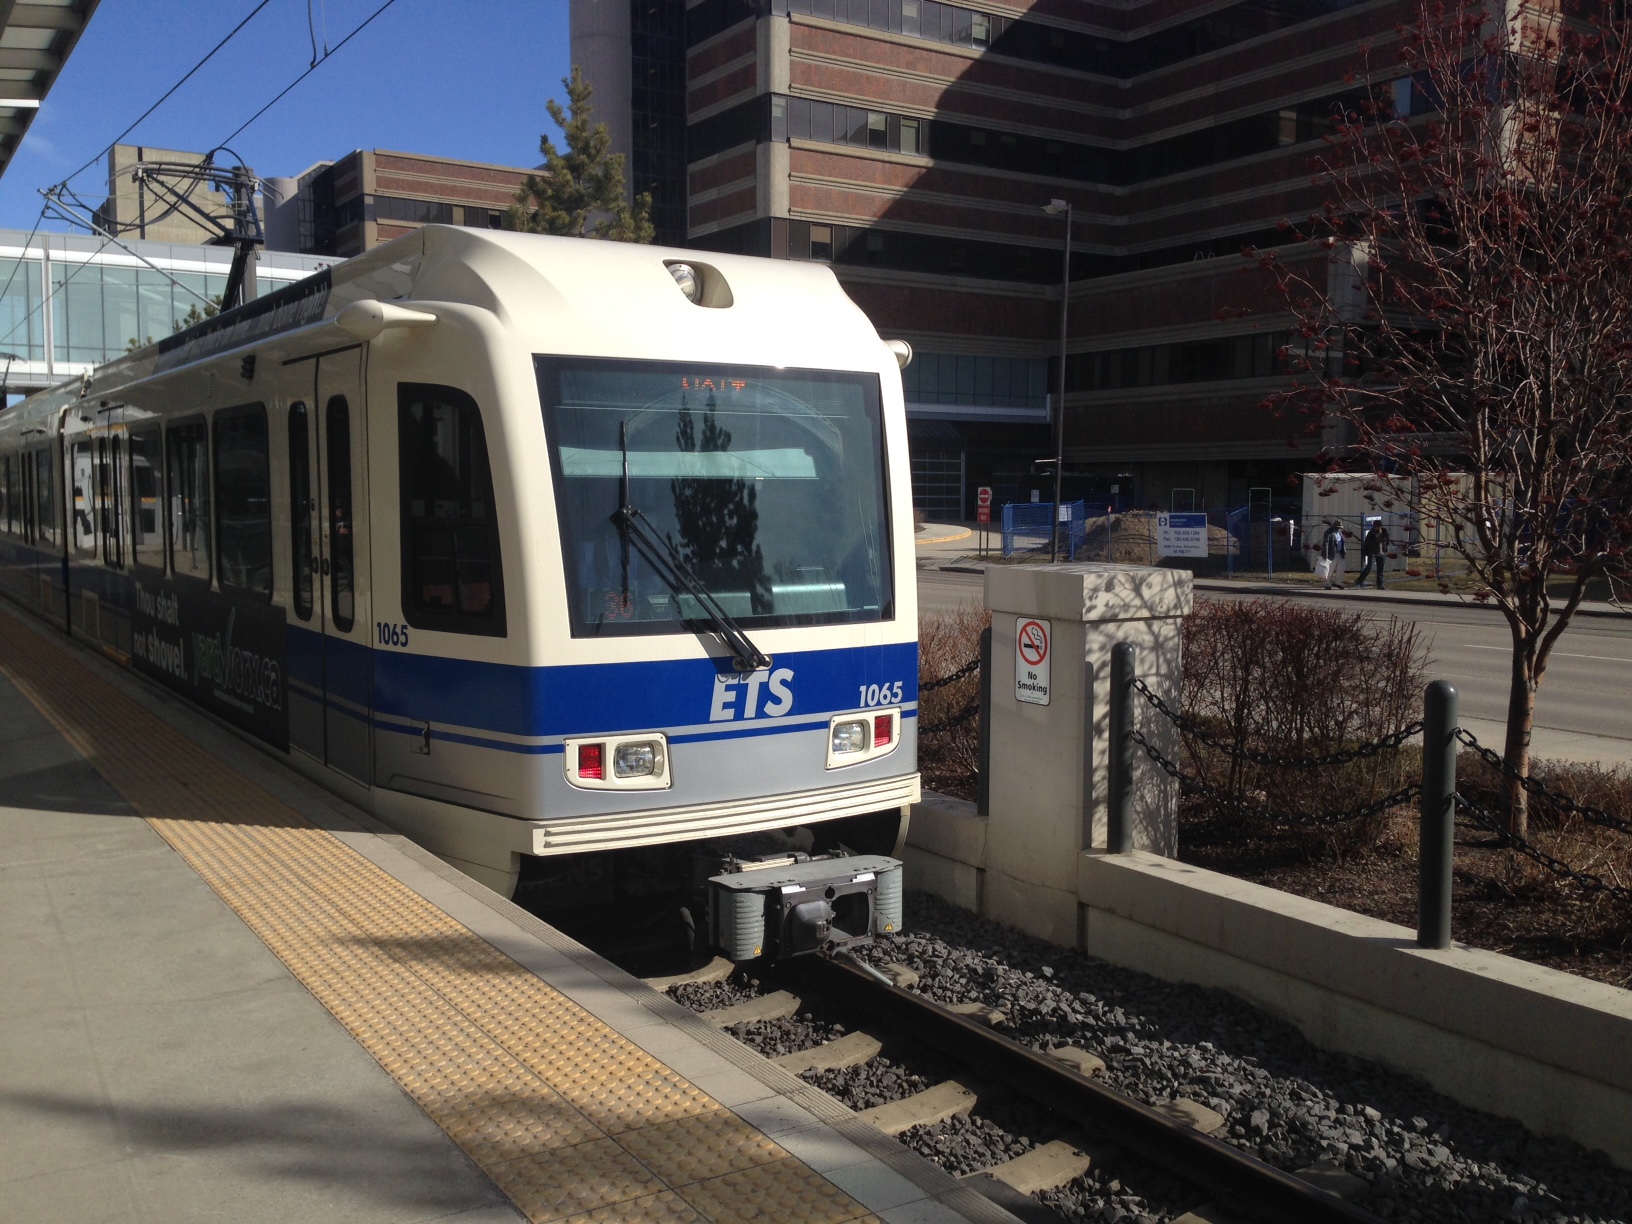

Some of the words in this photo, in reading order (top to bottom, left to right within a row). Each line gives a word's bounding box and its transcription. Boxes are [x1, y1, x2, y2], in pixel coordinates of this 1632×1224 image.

[134, 581, 155, 618] Thou
[156, 589, 179, 626] shalt
[133, 630, 147, 659] not
[376, 621, 409, 648] 1065
[1017, 680, 1048, 696] Smoking
[1027, 670, 1038, 681] No
[709, 667, 795, 722] ETS
[859, 681, 903, 708] 1065
